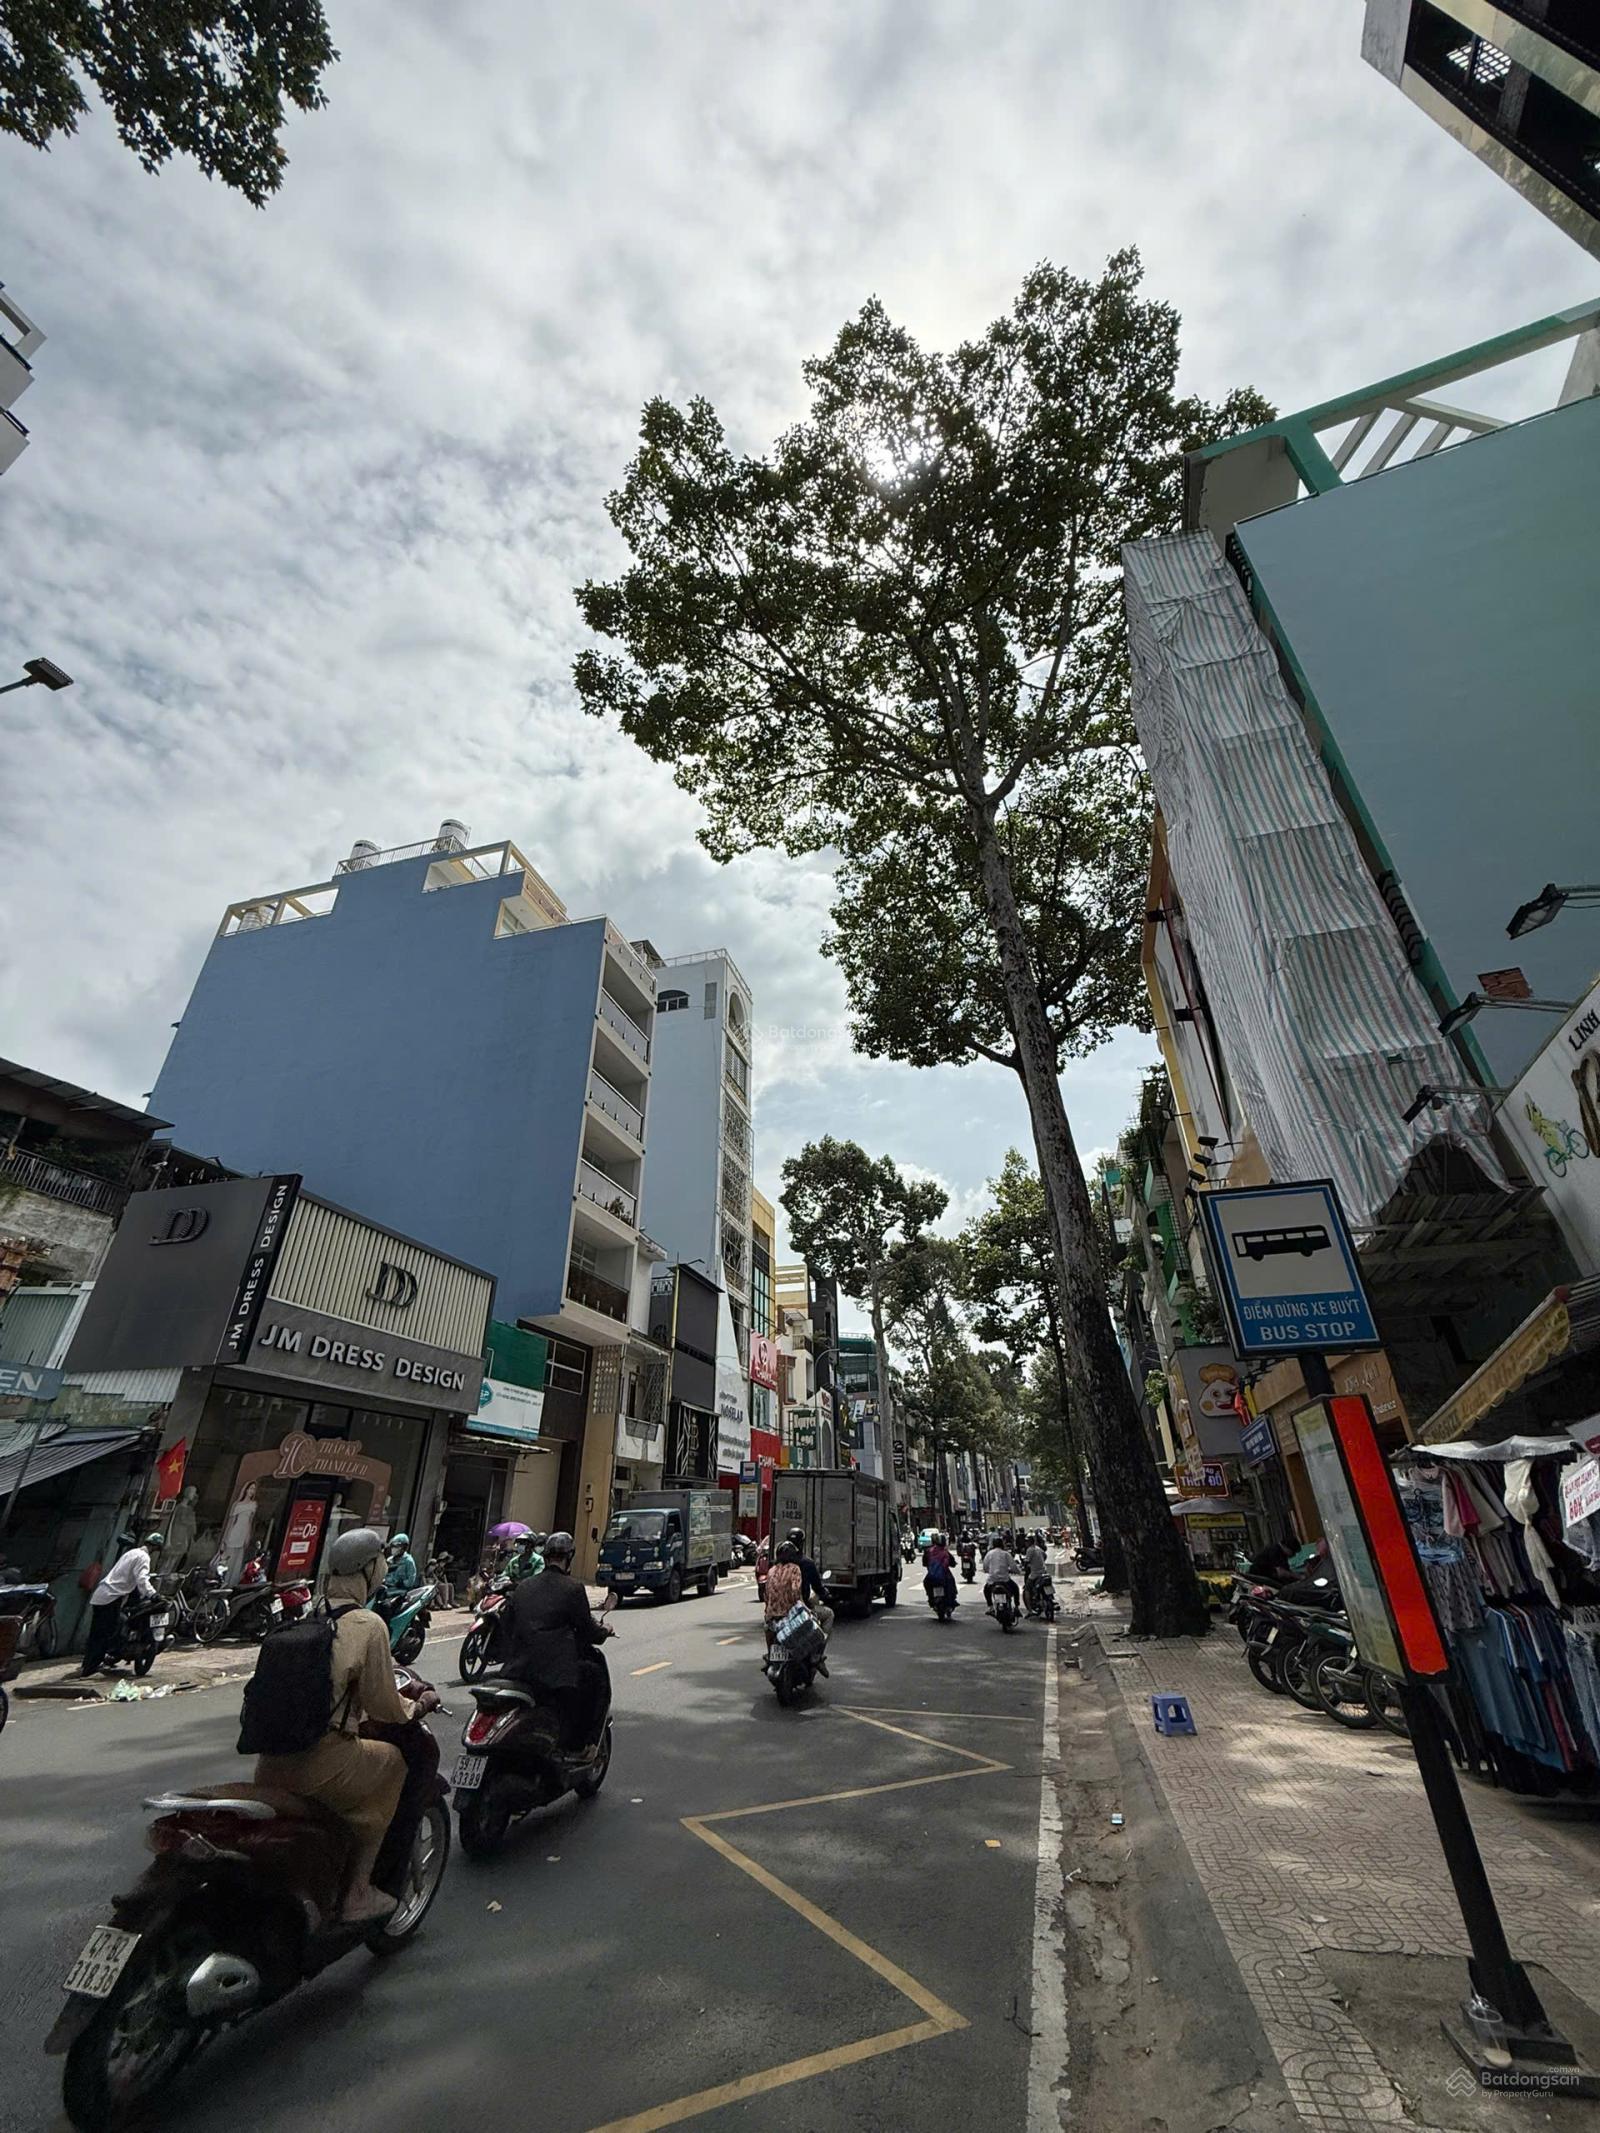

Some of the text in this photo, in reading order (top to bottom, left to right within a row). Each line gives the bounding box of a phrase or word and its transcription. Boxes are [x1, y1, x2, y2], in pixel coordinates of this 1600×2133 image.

[1568, 1008, 1600, 1051] LINH
[228, 1184, 288, 1350] JM DRESS DESIGN
[1275, 1301, 1309, 1318] DỪNG
[1311, 1301, 1328, 1316] XE
[1329, 1296, 1361, 1314] BUÝT
[1260, 1321, 1356, 1341] BUS STOP
[261, 1325, 465, 1391] JM DRESS DESIGN
